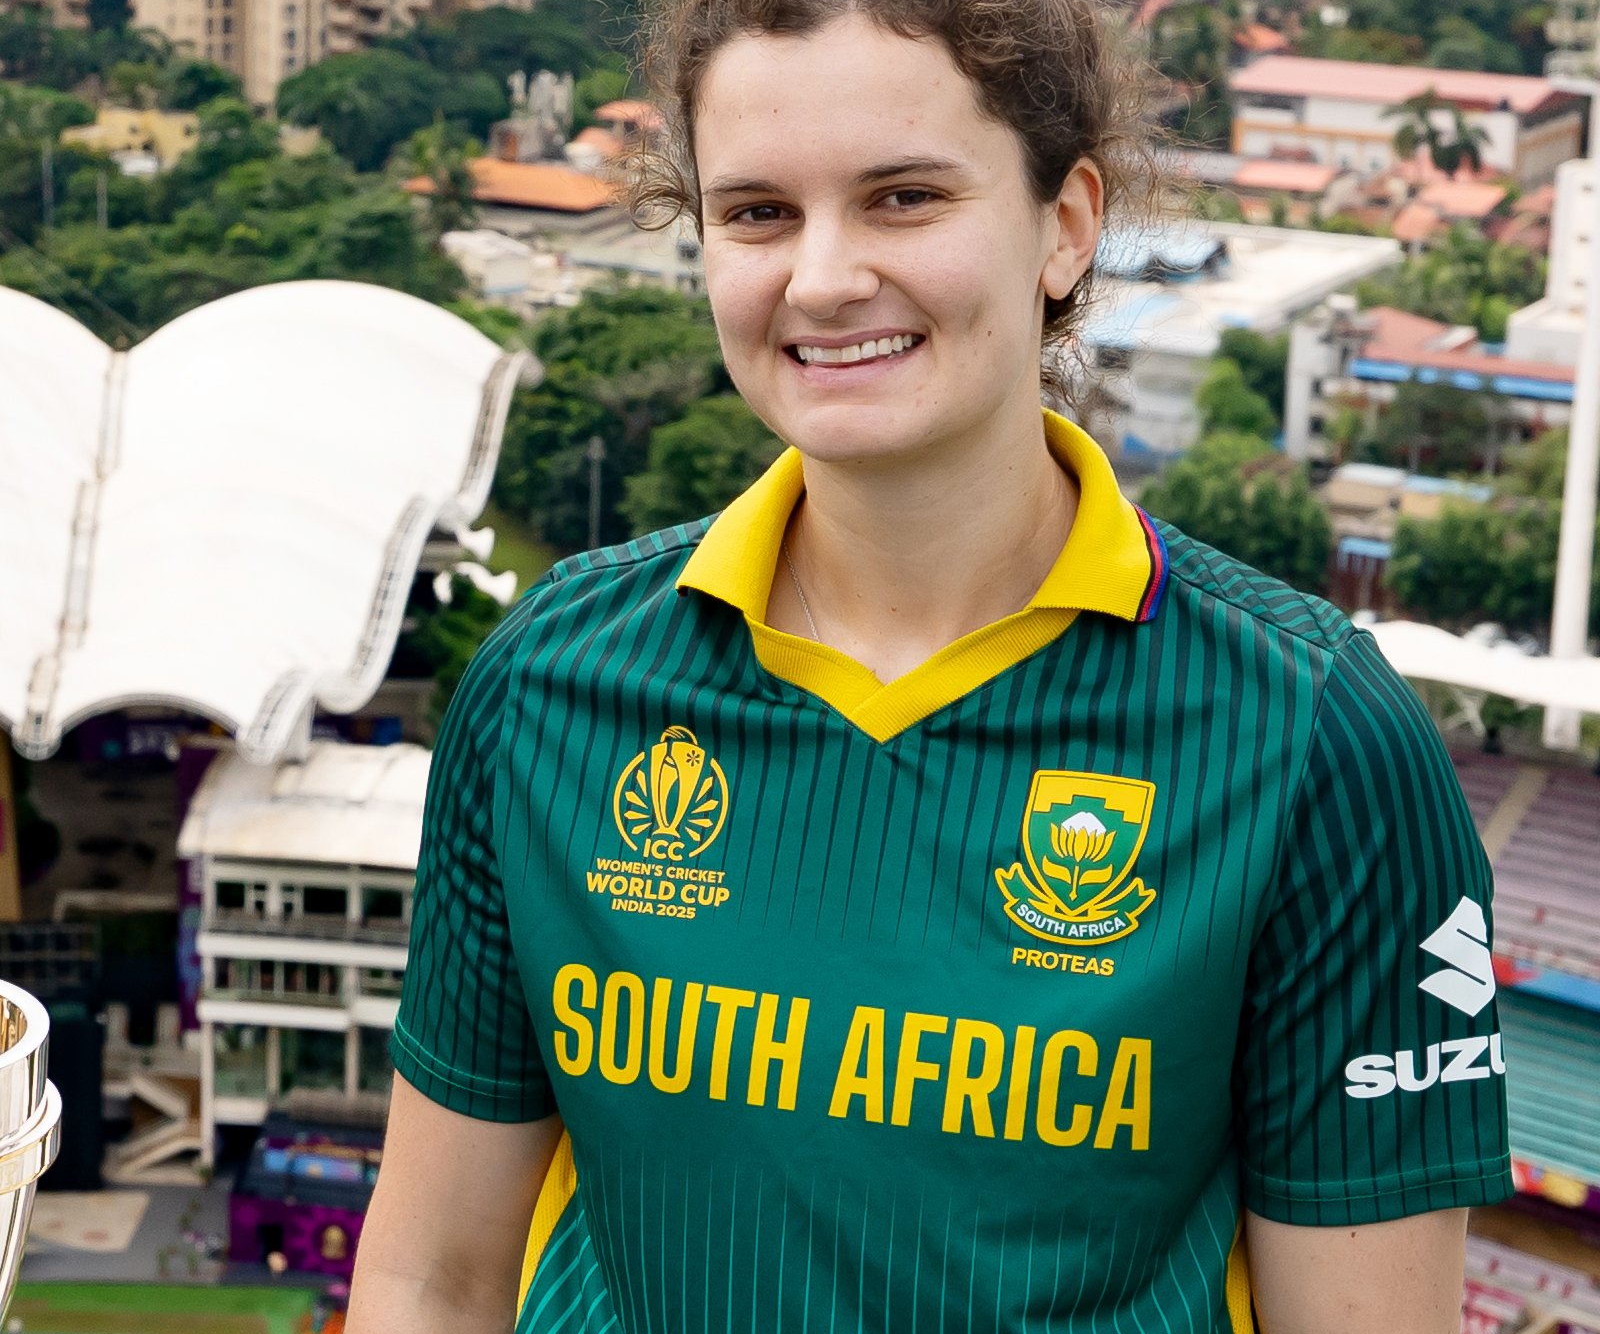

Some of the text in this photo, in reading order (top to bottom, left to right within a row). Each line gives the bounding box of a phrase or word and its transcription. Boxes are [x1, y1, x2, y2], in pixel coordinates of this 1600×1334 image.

[643, 839, 685, 861] ICC
[596, 858, 726, 884] WOMEN'S CRICKET
[586, 871, 730, 907] WORLD CUP
[611, 898, 696, 919] INDIA 2025
[1016, 903, 1126, 938] SOUTH AFRICA
[1012, 947, 1115, 977] PROTEAS
[553, 963, 1152, 1152] SOUTH AFRICA
